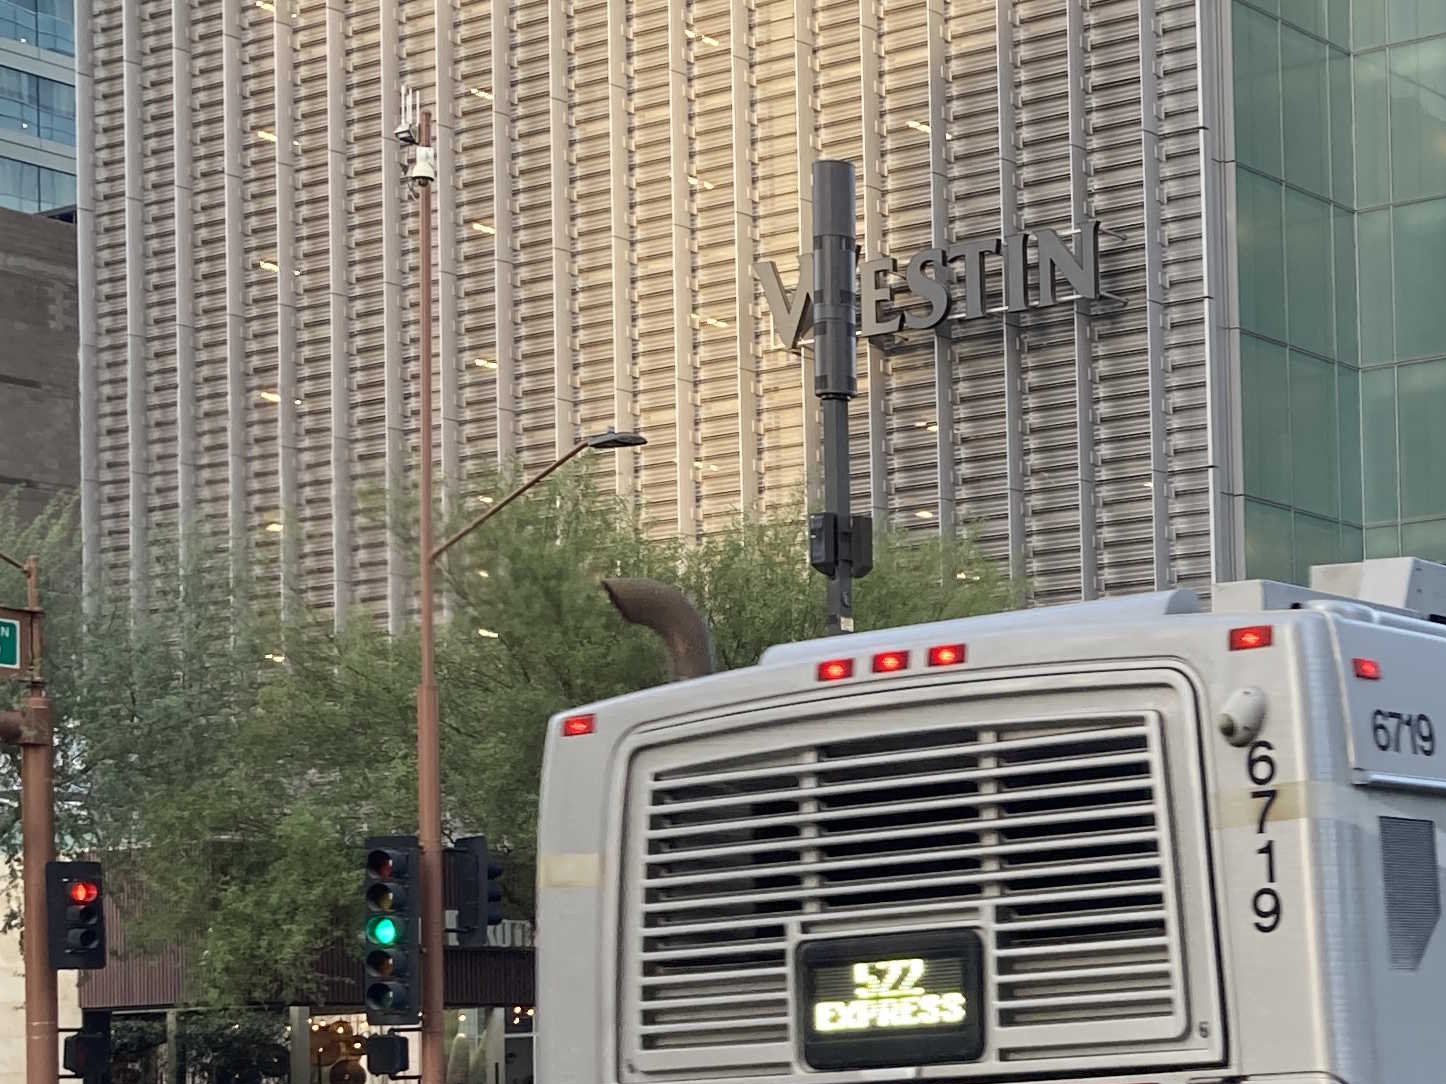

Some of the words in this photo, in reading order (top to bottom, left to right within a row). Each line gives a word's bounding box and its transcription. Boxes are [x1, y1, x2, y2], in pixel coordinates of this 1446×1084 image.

[752, 220, 1101, 349] WESTIN
[1371, 709, 1435, 758] 6719
[1248, 740, 1281, 933] 6719
[814, 992, 967, 1031] EXPRESS
